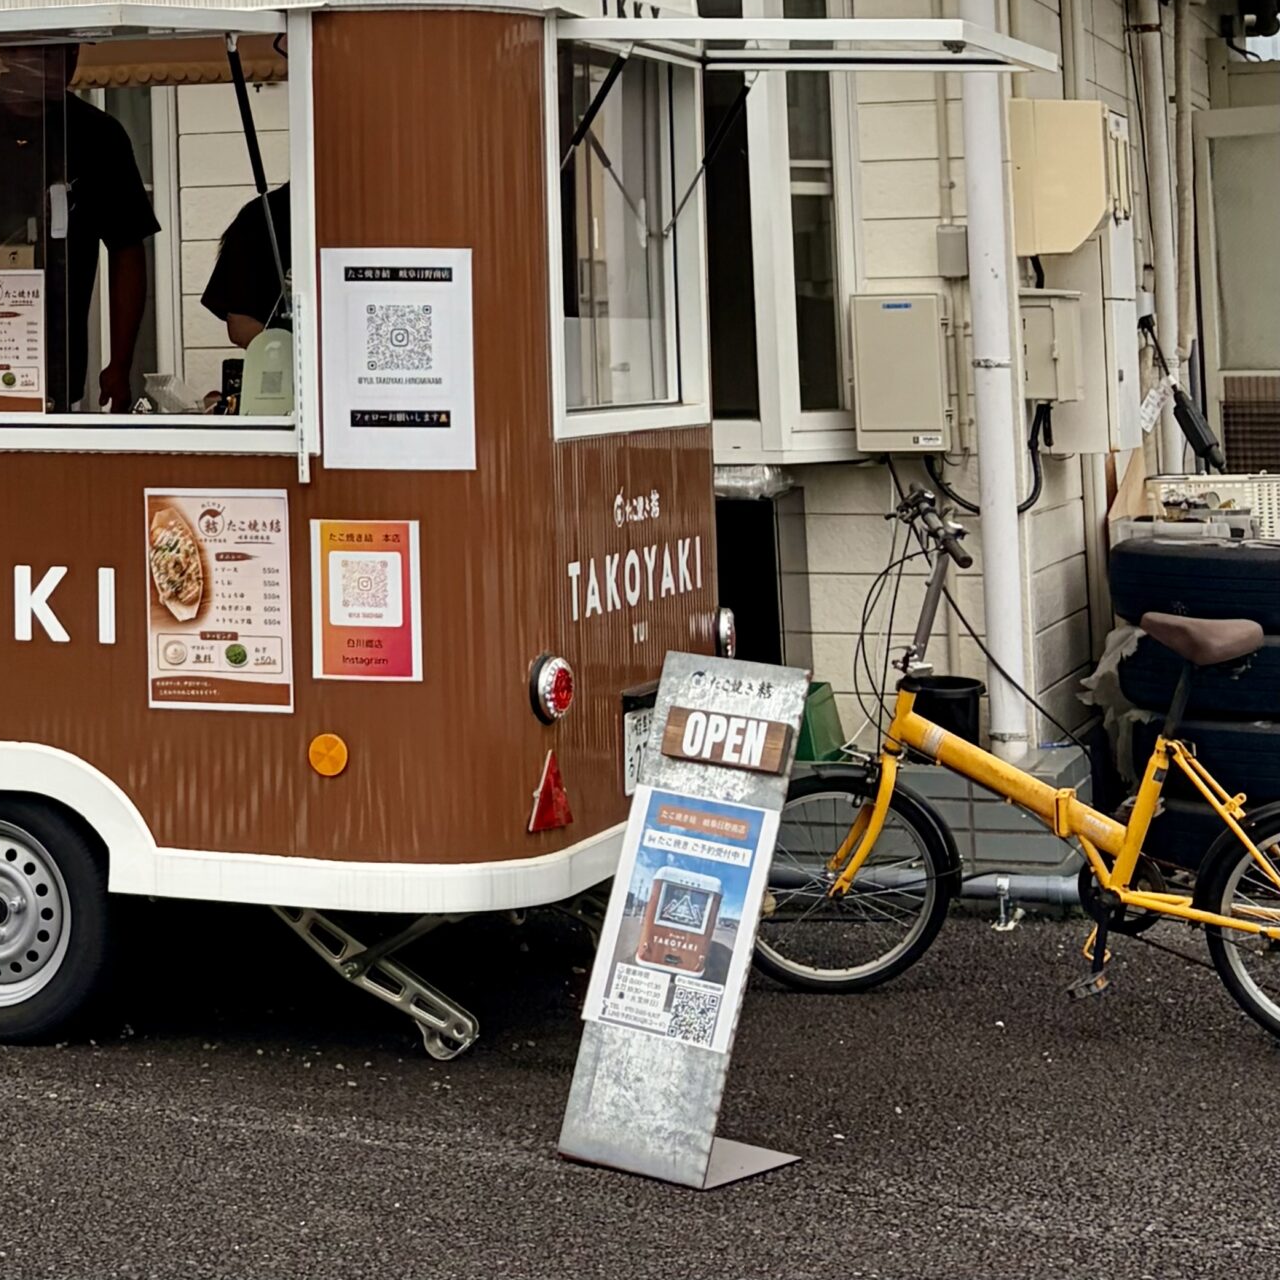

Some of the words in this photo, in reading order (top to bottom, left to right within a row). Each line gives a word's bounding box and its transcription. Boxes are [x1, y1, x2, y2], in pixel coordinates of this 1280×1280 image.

[226, 518, 282, 534] たこ焼き結
[329, 533, 373, 543] たこ焼き結
[382, 533, 401, 543] 本店
[568, 535, 702, 622] TAKOYAKI
[632, 621, 649, 644] YUI
[342, 655, 389, 666] Instagram
[682, 711, 769, 768] OPEN
